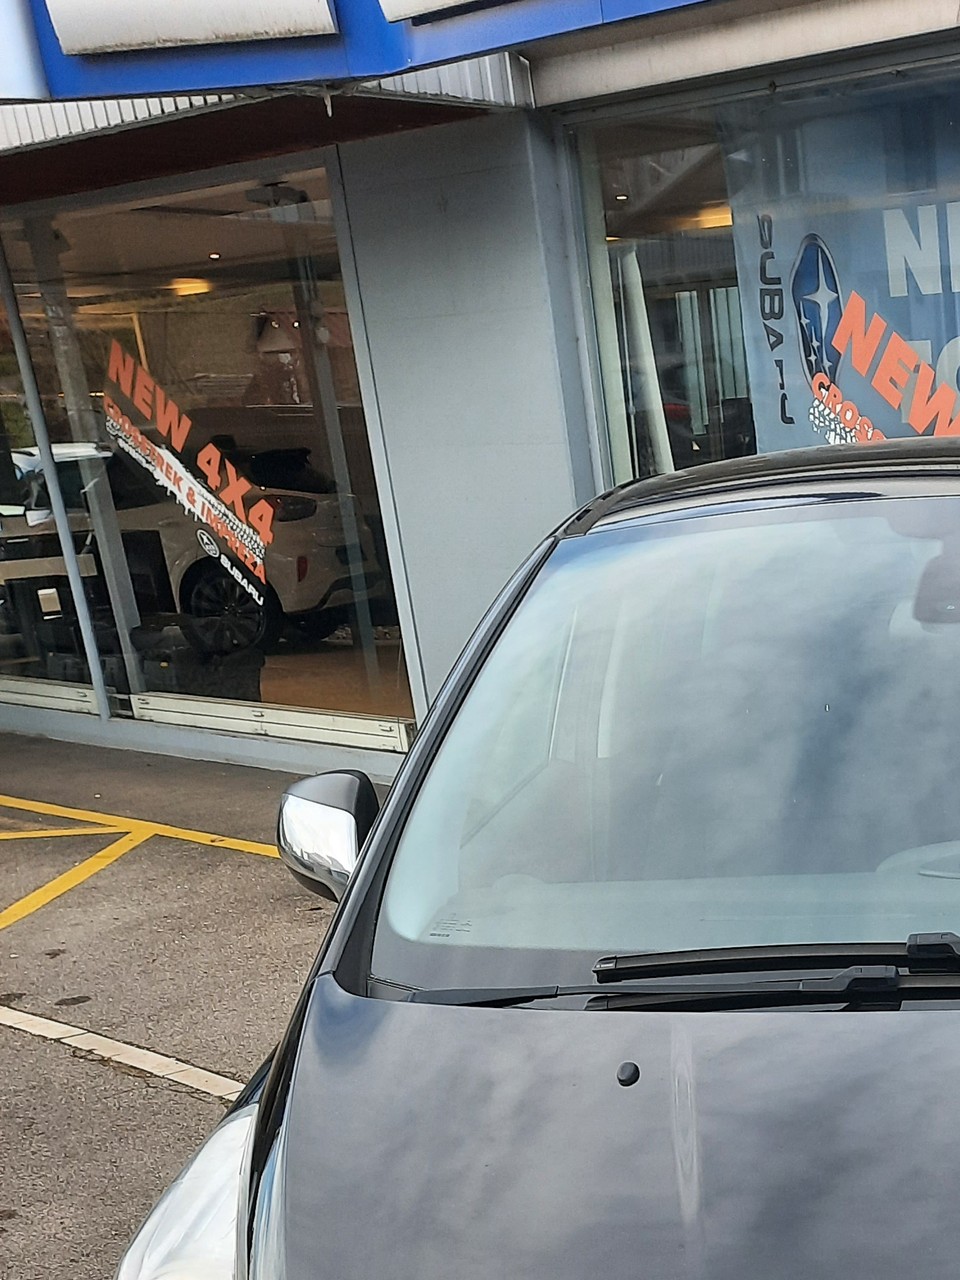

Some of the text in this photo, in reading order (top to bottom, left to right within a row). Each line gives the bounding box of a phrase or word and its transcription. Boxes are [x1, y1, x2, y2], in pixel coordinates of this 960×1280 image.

[107, 338, 276, 546] NEW 4X4
[219, 553, 264, 606] SUBARU
